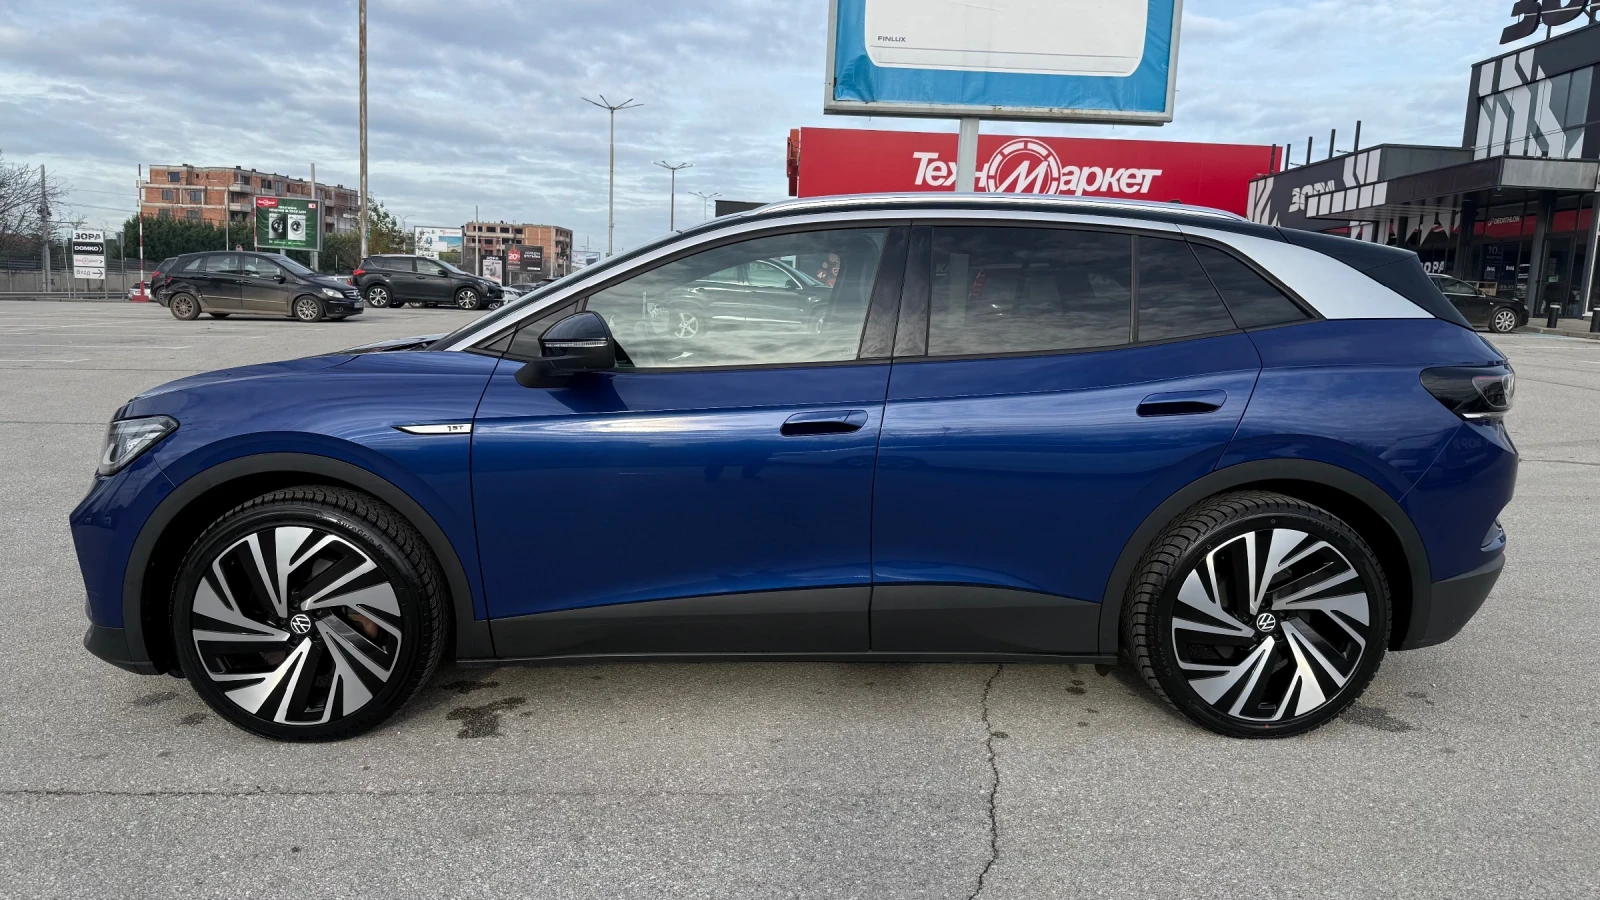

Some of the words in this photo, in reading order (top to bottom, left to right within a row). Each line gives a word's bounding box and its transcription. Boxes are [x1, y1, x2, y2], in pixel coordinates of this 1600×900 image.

[877, 35, 906, 43] FINLUX
[74, 232, 101, 240] ЗОРА
[1420, 260, 1445, 273] ОРА
